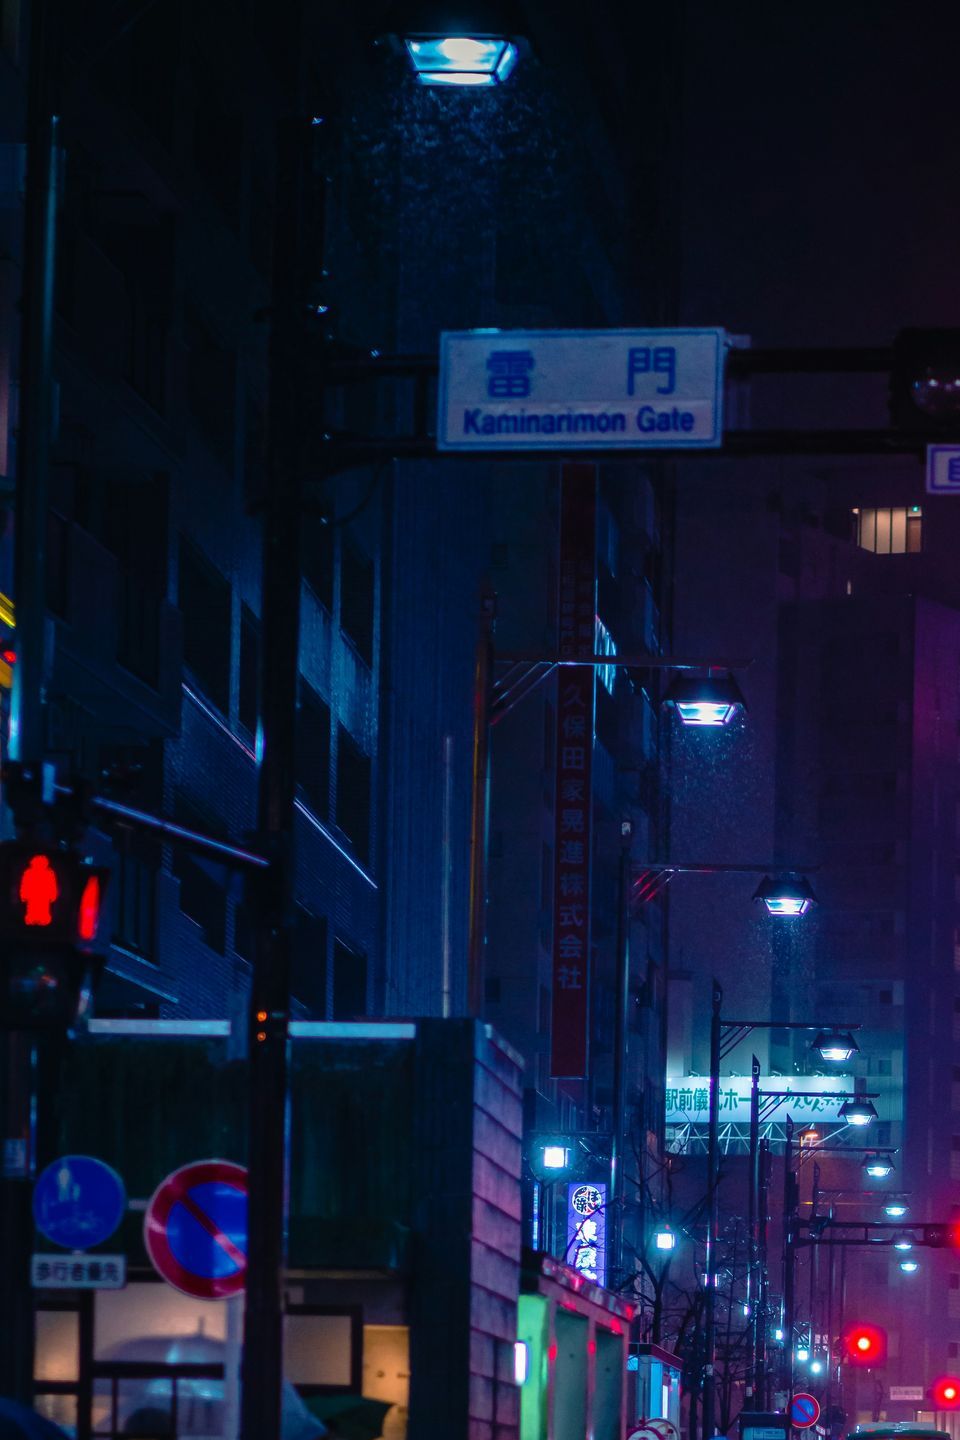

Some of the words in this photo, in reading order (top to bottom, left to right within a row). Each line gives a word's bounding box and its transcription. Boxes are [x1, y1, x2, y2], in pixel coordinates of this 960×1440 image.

[486, 346, 676, 398] 雷門
[463, 407, 626, 436] Kaminarimon
[636, 405, 695, 432] Gate
